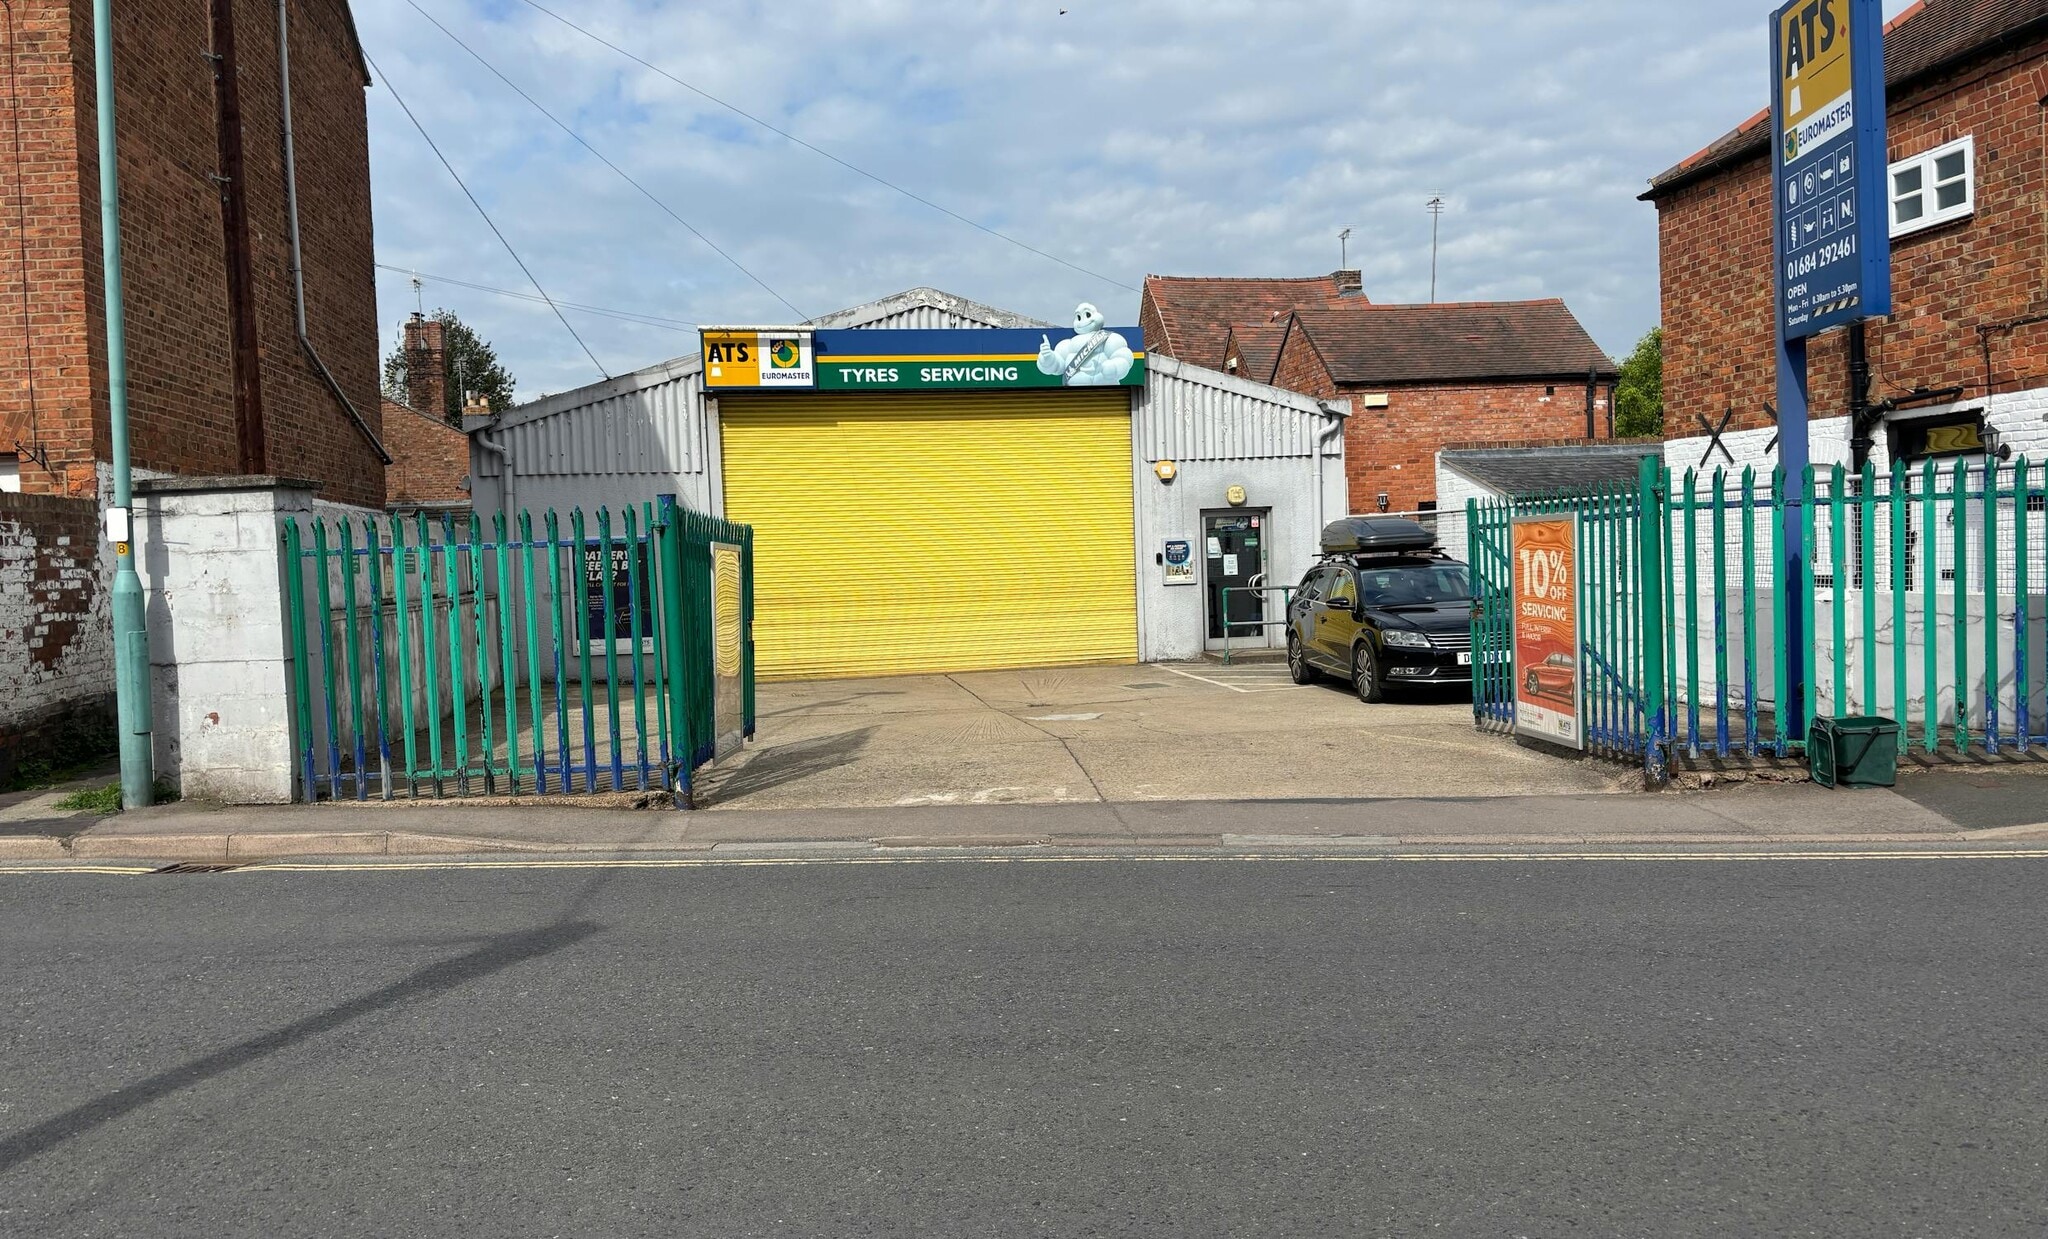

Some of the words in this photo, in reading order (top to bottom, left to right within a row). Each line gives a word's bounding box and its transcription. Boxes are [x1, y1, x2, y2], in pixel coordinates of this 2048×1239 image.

[1798, 101, 1852, 147] EUROMASTER
[1787, 252, 1817, 280] 01684
[1818, 234, 1856, 269] 292461
[1787, 282, 1808, 299] OPEN
[1788, 313, 1809, 327] Saturday
[761, 372, 810, 380] EUROMASTER
[839, 368, 899, 383] TYRES
[920, 366, 1018, 382] SERVICING
[118, 544, 125, 554] 8
[1519, 549, 1567, 598] 10%
[1549, 585, 1568, 601] OFF
